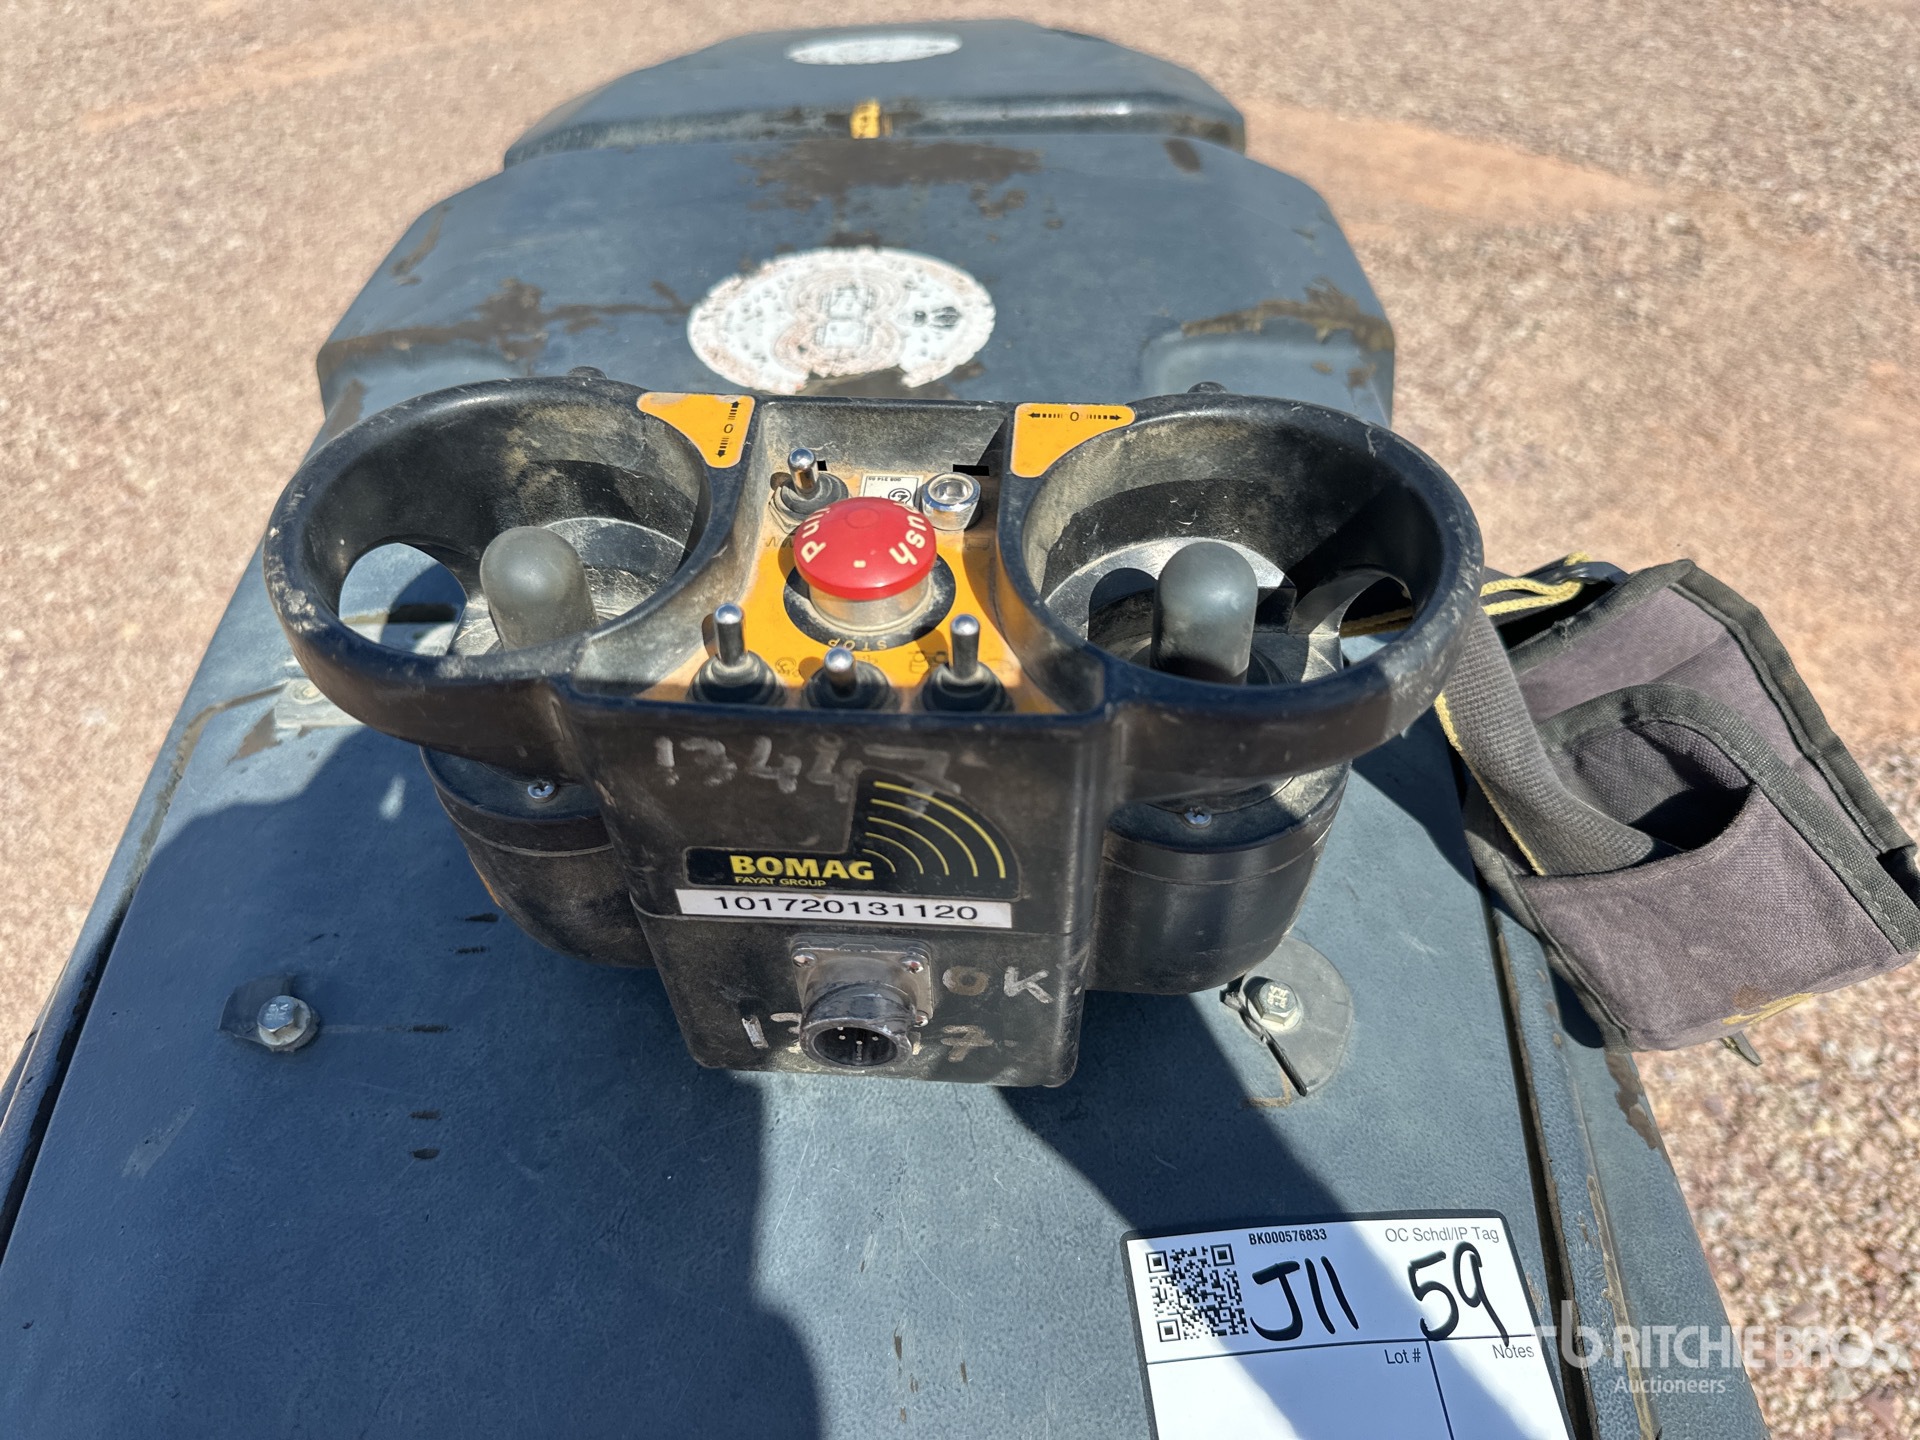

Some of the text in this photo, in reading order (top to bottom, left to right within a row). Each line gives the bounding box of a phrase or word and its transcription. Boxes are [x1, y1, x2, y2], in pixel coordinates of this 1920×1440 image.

[827, 637, 888, 651] STOP
[729, 855, 875, 881] BOMAG
[735, 876, 827, 887] FAYAT GROUP
[714, 896, 979, 921] 101720131120
[1248, 1228, 1327, 1245] BK000576833
[1385, 1228, 1409, 1243] OC
[1470, 1226, 1499, 1244] Tag
[1408, 1241, 1510, 1347] 59
[1385, 1348, 1409, 1365] Lot
[1492, 1343, 1535, 1360] Notes
